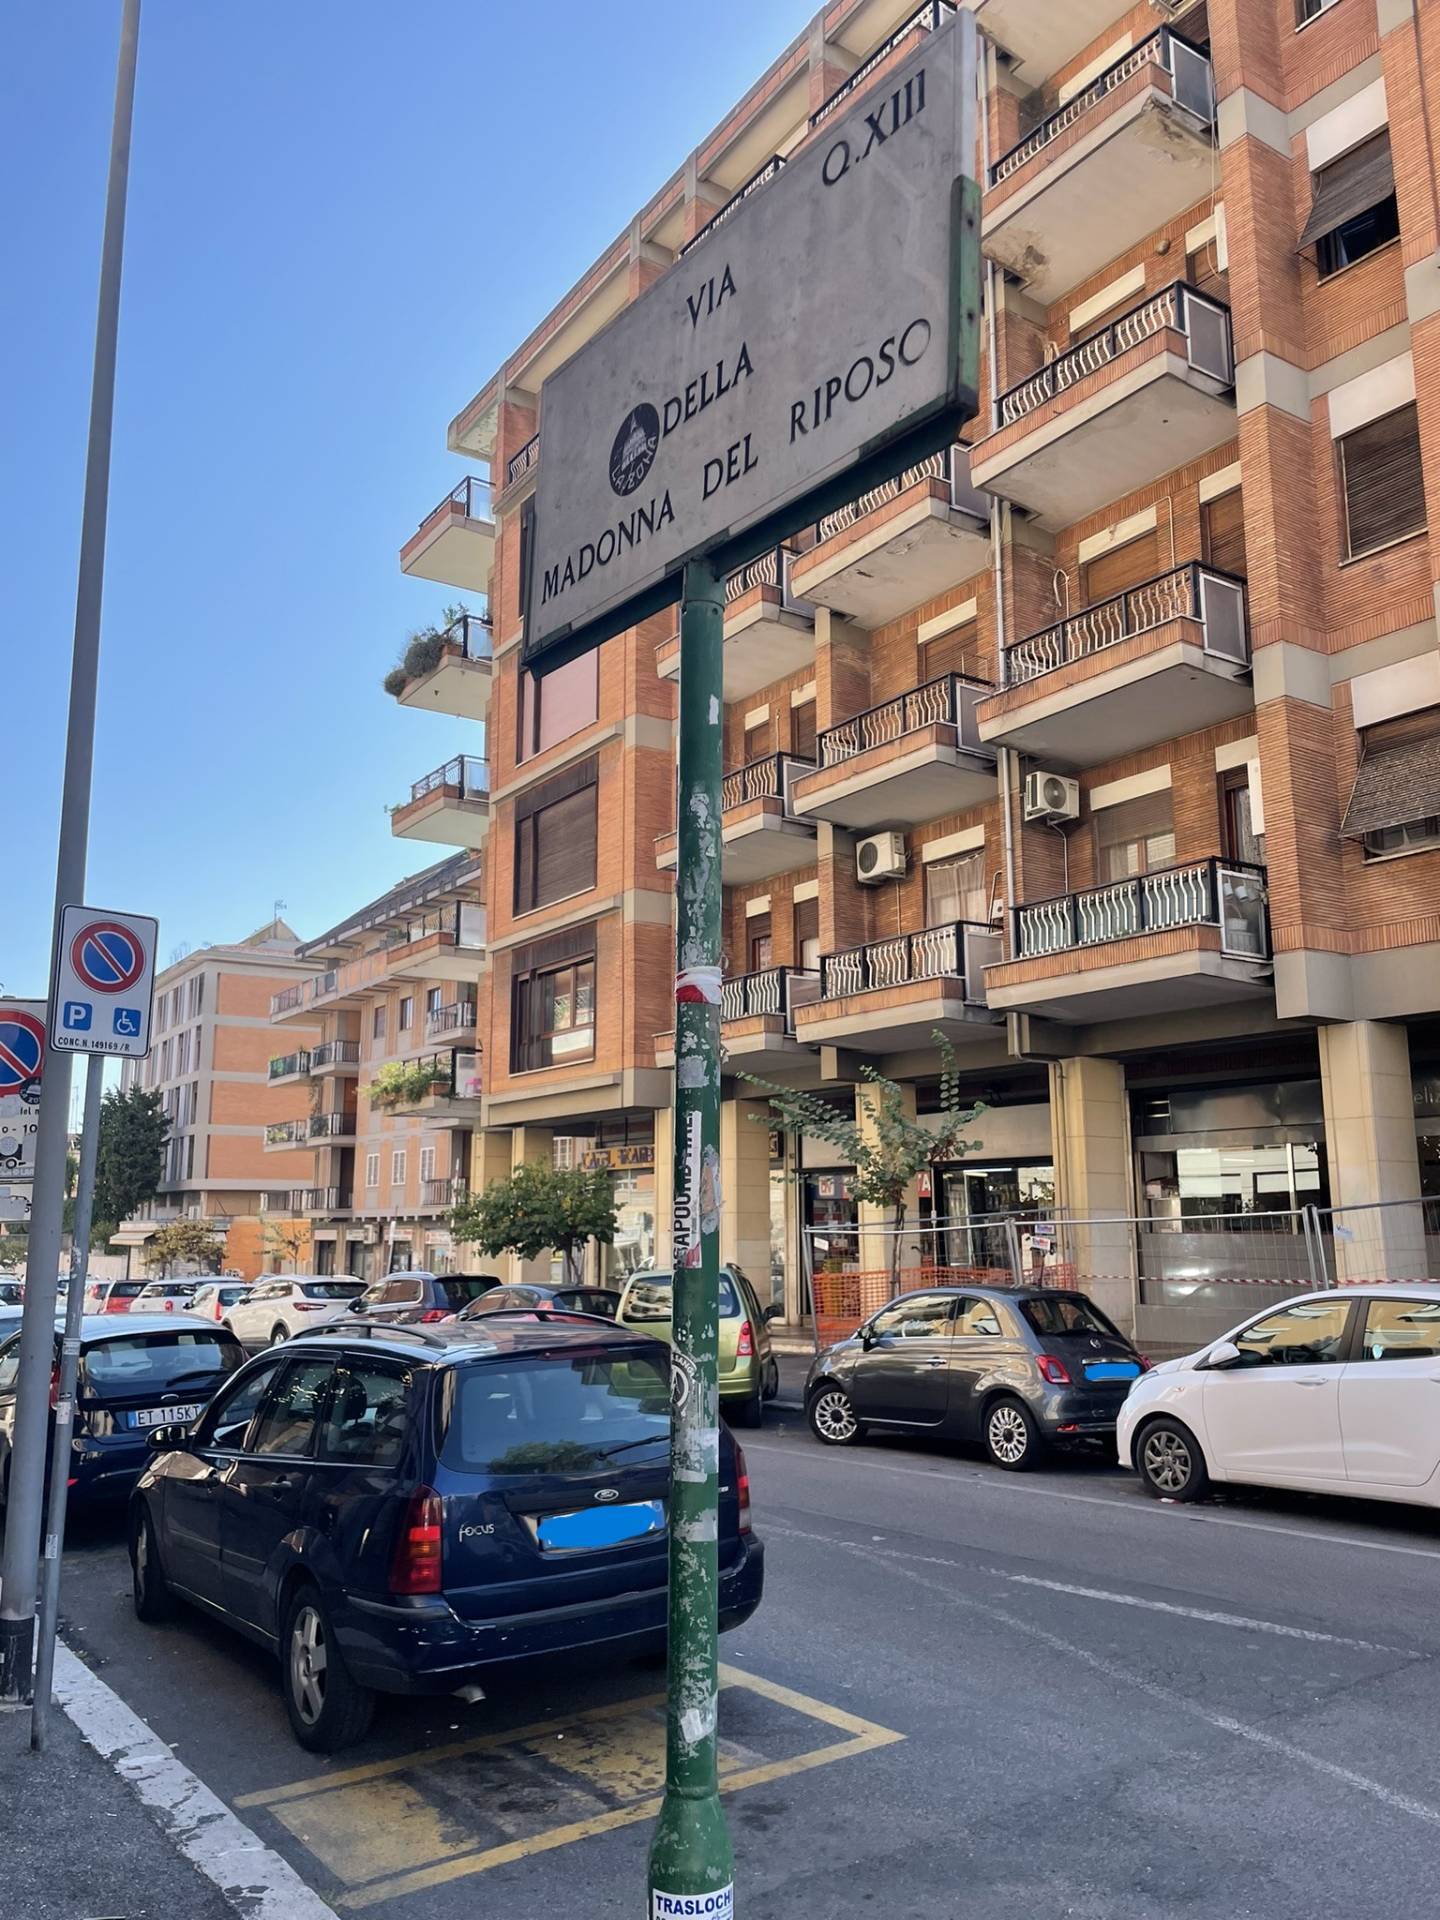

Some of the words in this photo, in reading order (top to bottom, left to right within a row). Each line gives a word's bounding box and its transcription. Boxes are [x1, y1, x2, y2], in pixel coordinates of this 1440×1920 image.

[685, 263, 738, 329] VIA
[662, 341, 755, 441] DELLA
[541, 489, 676, 605] MADONNA
[702, 432, 760, 502] DEL
[789, 317, 932, 446] RIPOSO
[69, 1005, 86, 1026] P
[138, 1411, 154, 1425] ET
